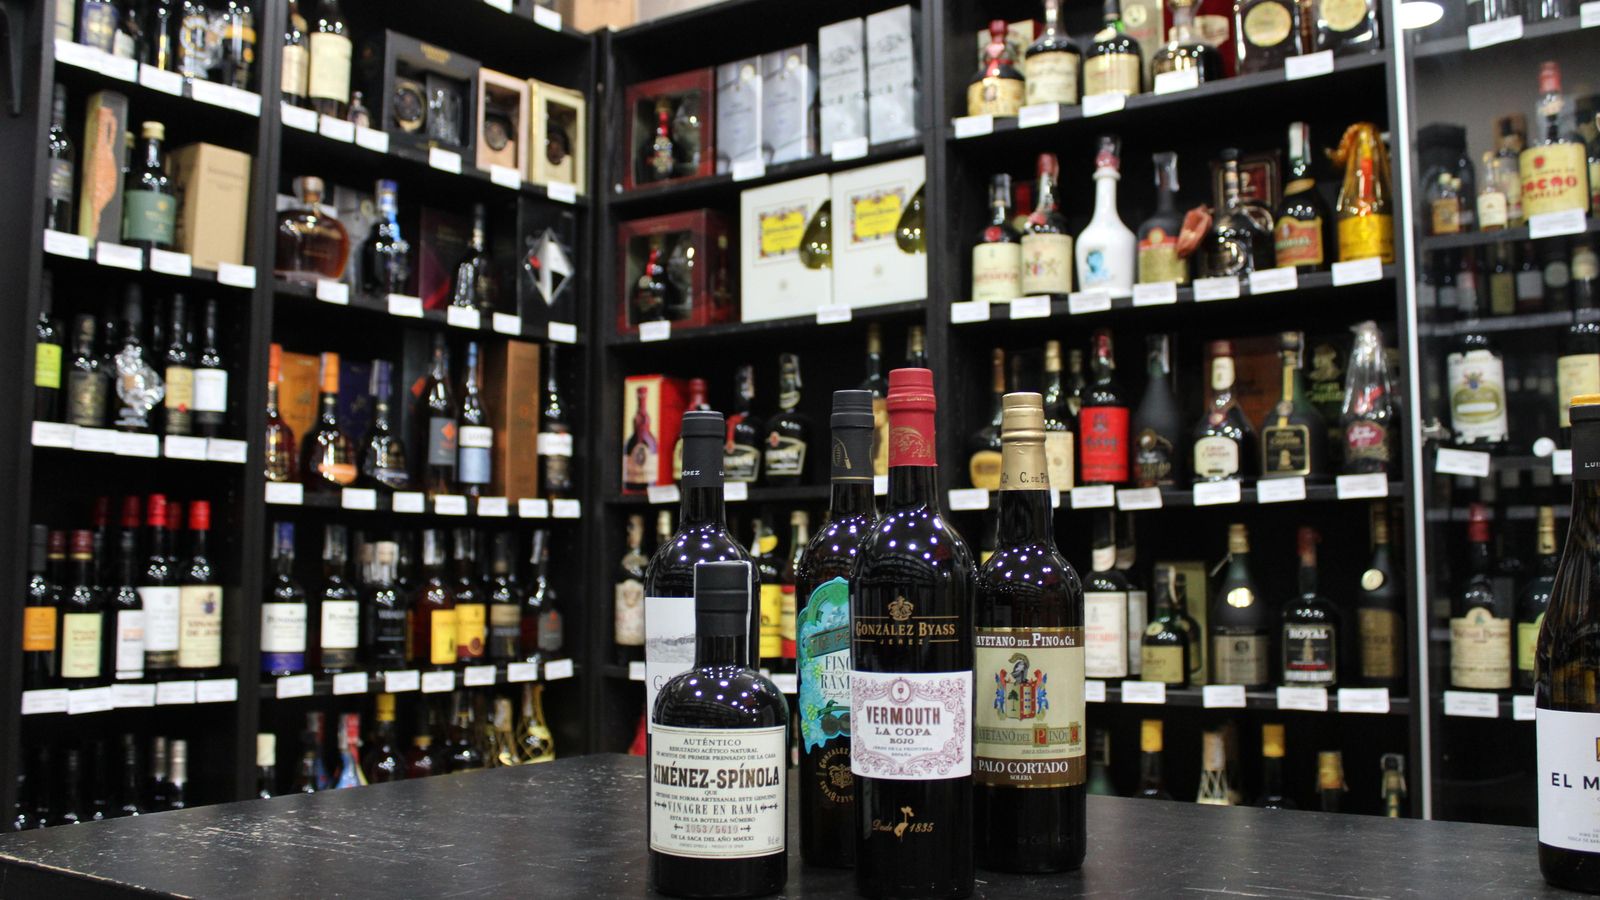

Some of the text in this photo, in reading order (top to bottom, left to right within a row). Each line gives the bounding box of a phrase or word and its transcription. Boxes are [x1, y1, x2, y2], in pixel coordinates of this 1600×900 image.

[918, 622, 955, 637] BYASS
[1017, 639, 1030, 647] DEL
[1032, 632, 1059, 647] PINO
[866, 705, 941, 725] VERMOUTH
[875, 727, 932, 737] LA COPA
[683, 737, 742, 747] AUTÉNTICO
[978, 759, 1069, 774] PALO CORTADO
[653, 760, 780, 789] XIMÉNEZ-SPÍNOLA
[1551, 772, 1573, 788] EL
[666, 801, 759, 815] VINAGRE EN RAMA
[909, 822, 935, 833] 1835
